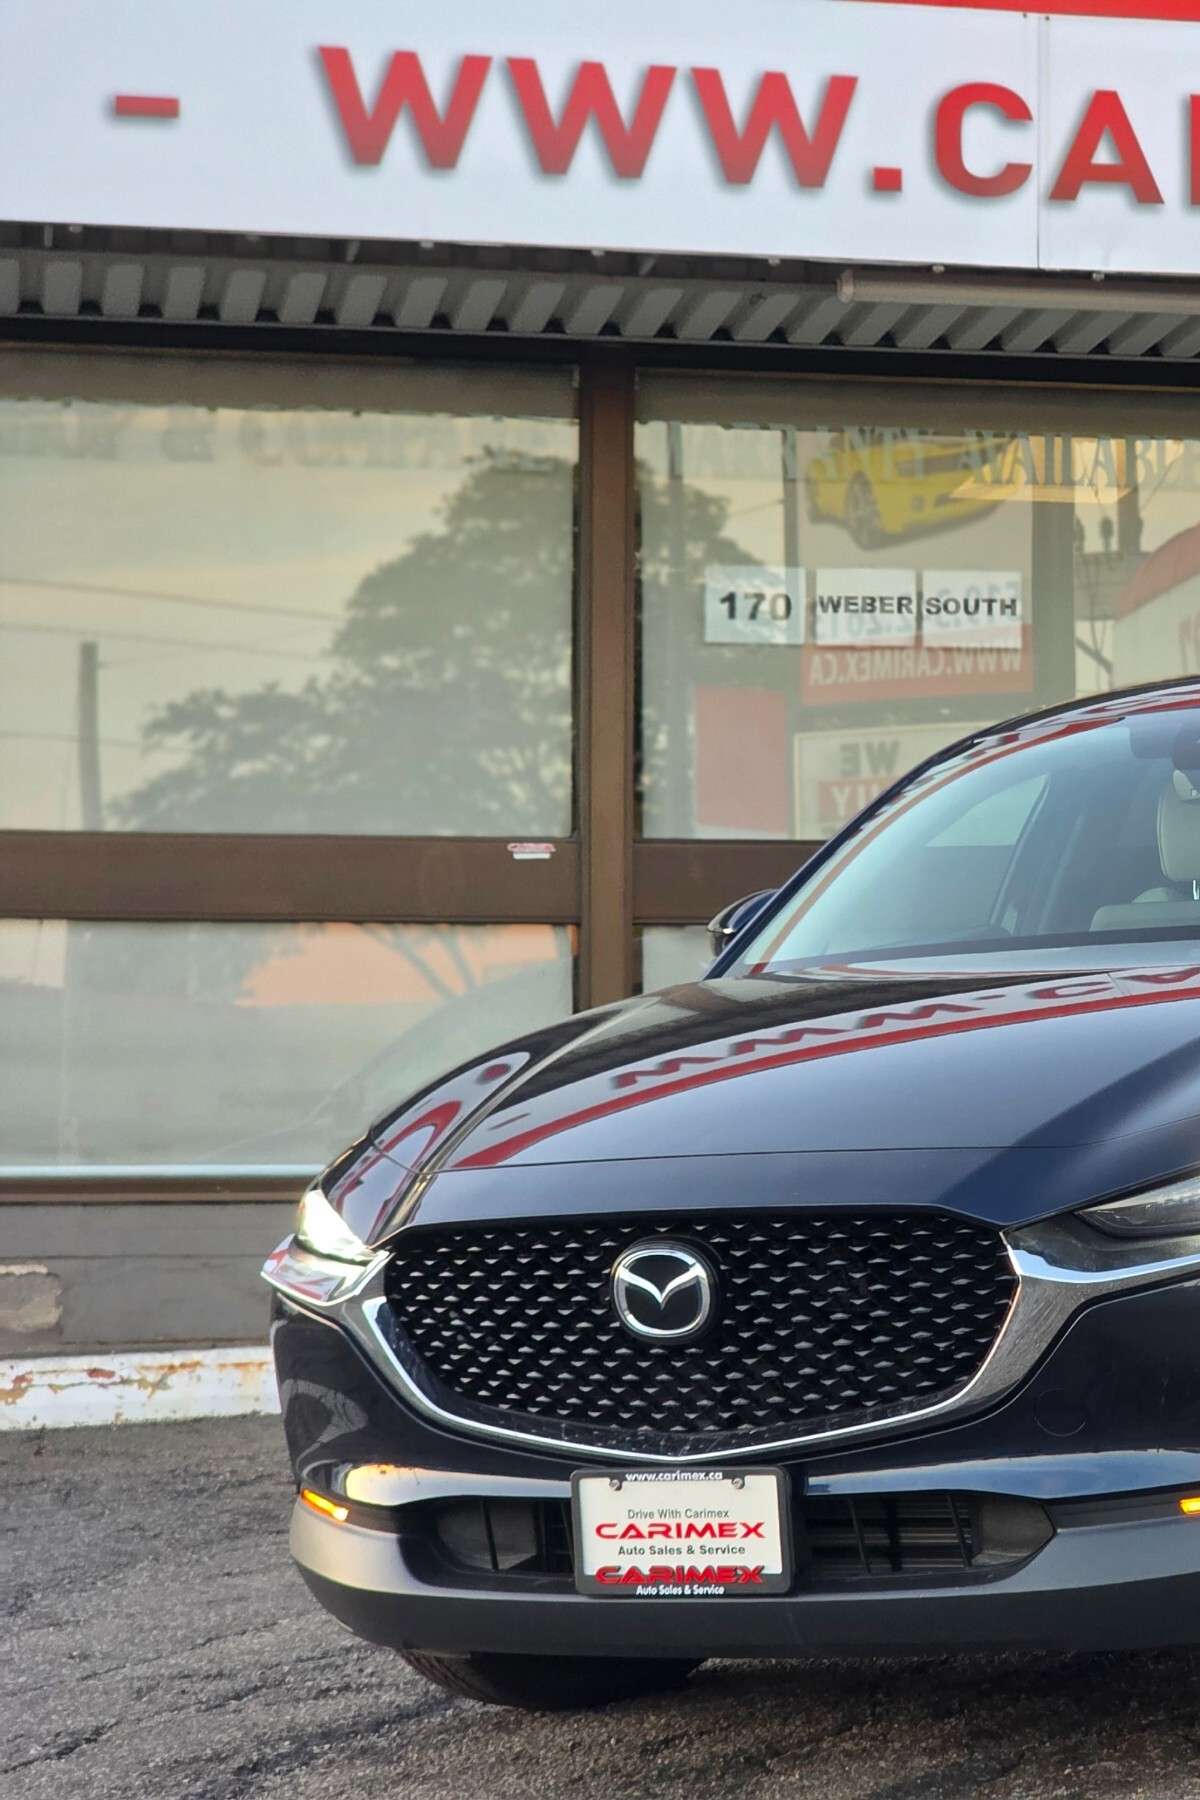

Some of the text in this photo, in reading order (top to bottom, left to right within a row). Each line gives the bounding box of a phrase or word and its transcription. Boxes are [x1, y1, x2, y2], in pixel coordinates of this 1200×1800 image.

[719, 592, 1018, 622] 170 WEBER SOUTH
[625, 1470, 724, 1482] www.carimex.ca
[627, 1508, 729, 1520] Drive With Carimex
[595, 1522, 766, 1540] CARIMEX
[618, 1544, 746, 1556] Auto Sales & Service
[594, 1565, 766, 1585] CARIMEX
[636, 1585, 657, 1595] Auto
[684, 1585, 692, 1595] &
[692, 1584, 725, 1595] Service
